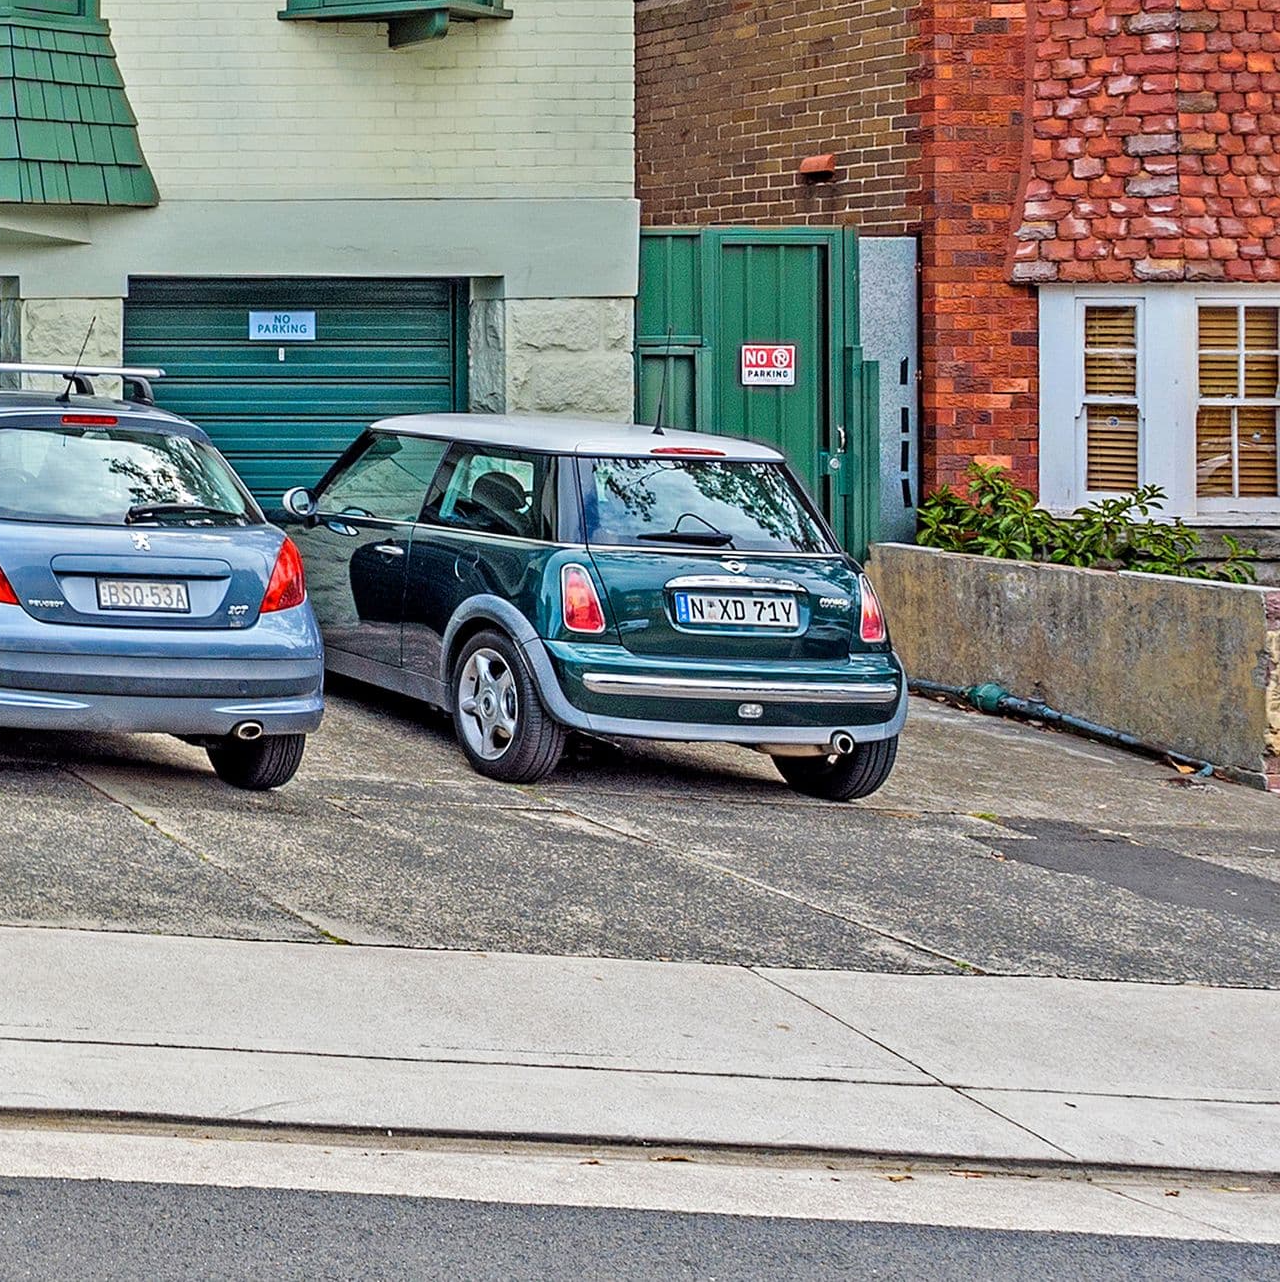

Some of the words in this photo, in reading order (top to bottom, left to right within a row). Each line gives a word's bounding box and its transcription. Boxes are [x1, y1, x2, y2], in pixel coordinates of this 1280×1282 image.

[274, 314, 291, 324] NO
[257, 324, 307, 334] PARKING
[745, 350, 767, 366] NO
[747, 369, 789, 378] PARKING
